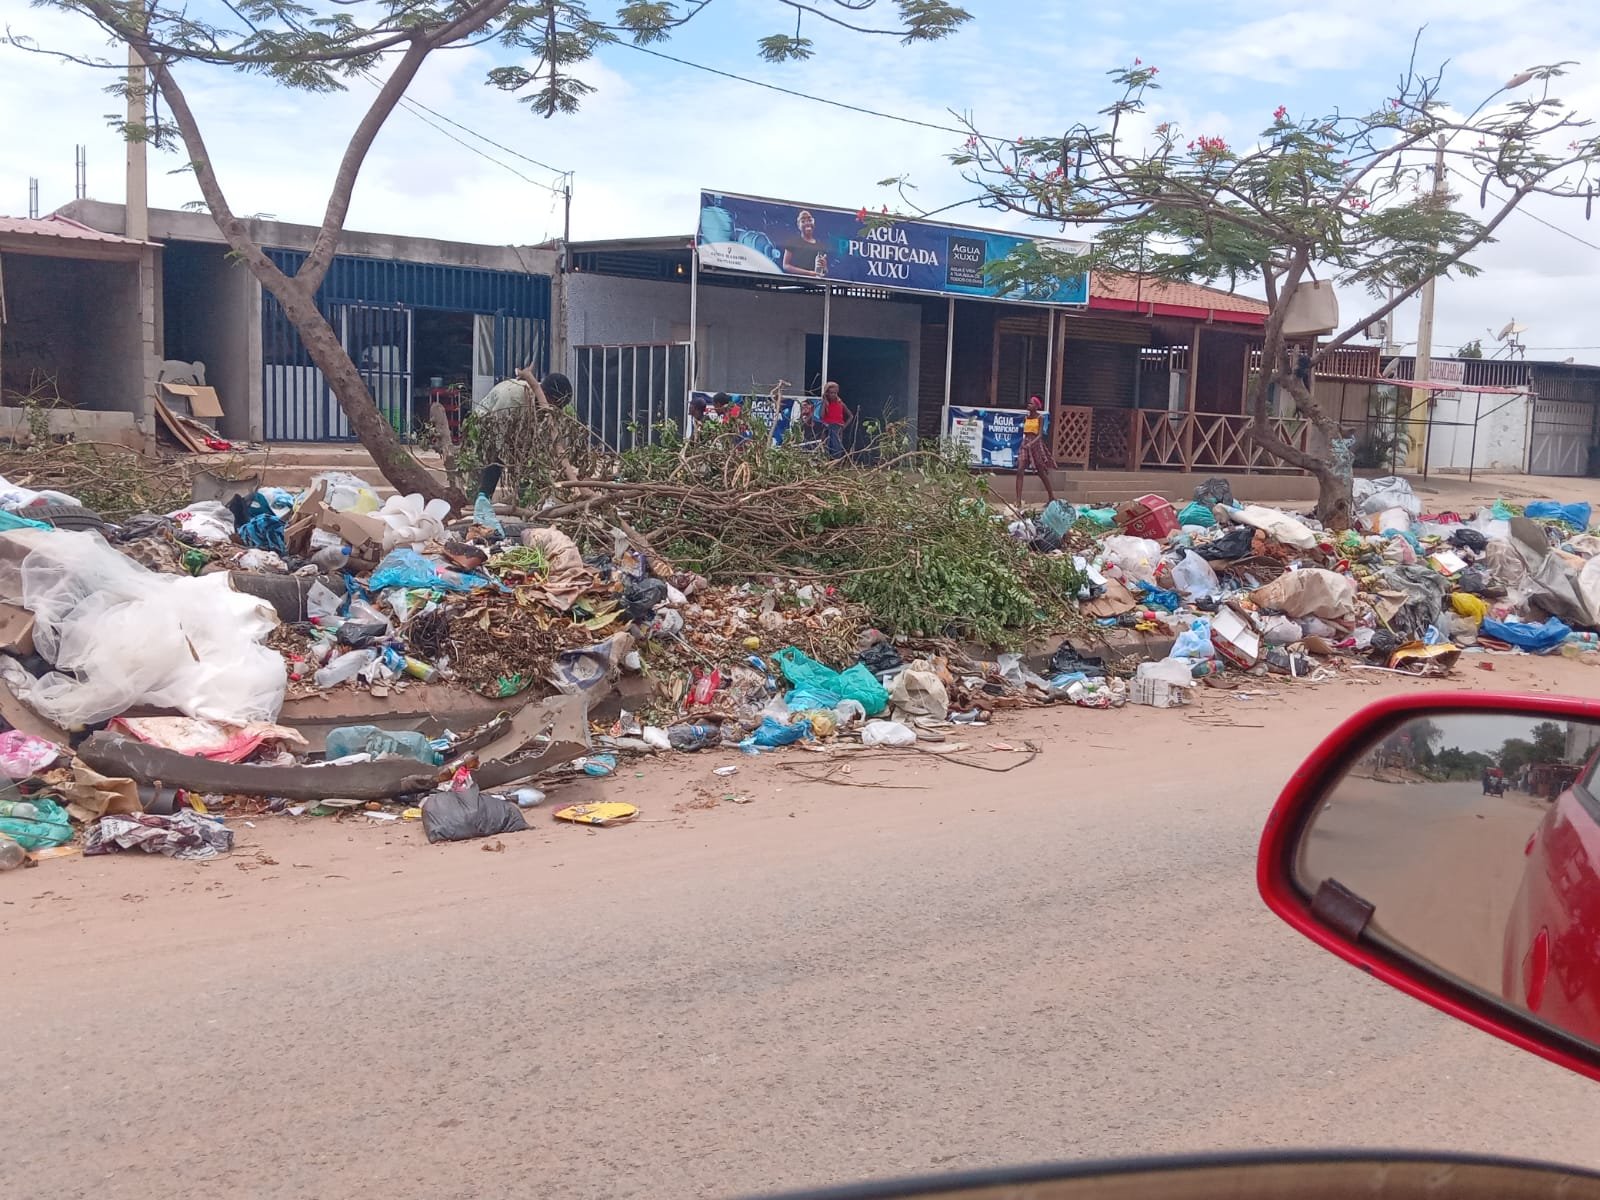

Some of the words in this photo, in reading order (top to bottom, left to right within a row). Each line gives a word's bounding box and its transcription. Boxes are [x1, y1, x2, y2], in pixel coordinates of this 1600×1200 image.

[952, 243, 981, 254] ÁGUA
[953, 253, 979, 262] XUXU
[867, 260, 910, 280] XUXU
[993, 413, 1014, 426] ÁGUA
[988, 425, 1019, 433] PURIFICADA
